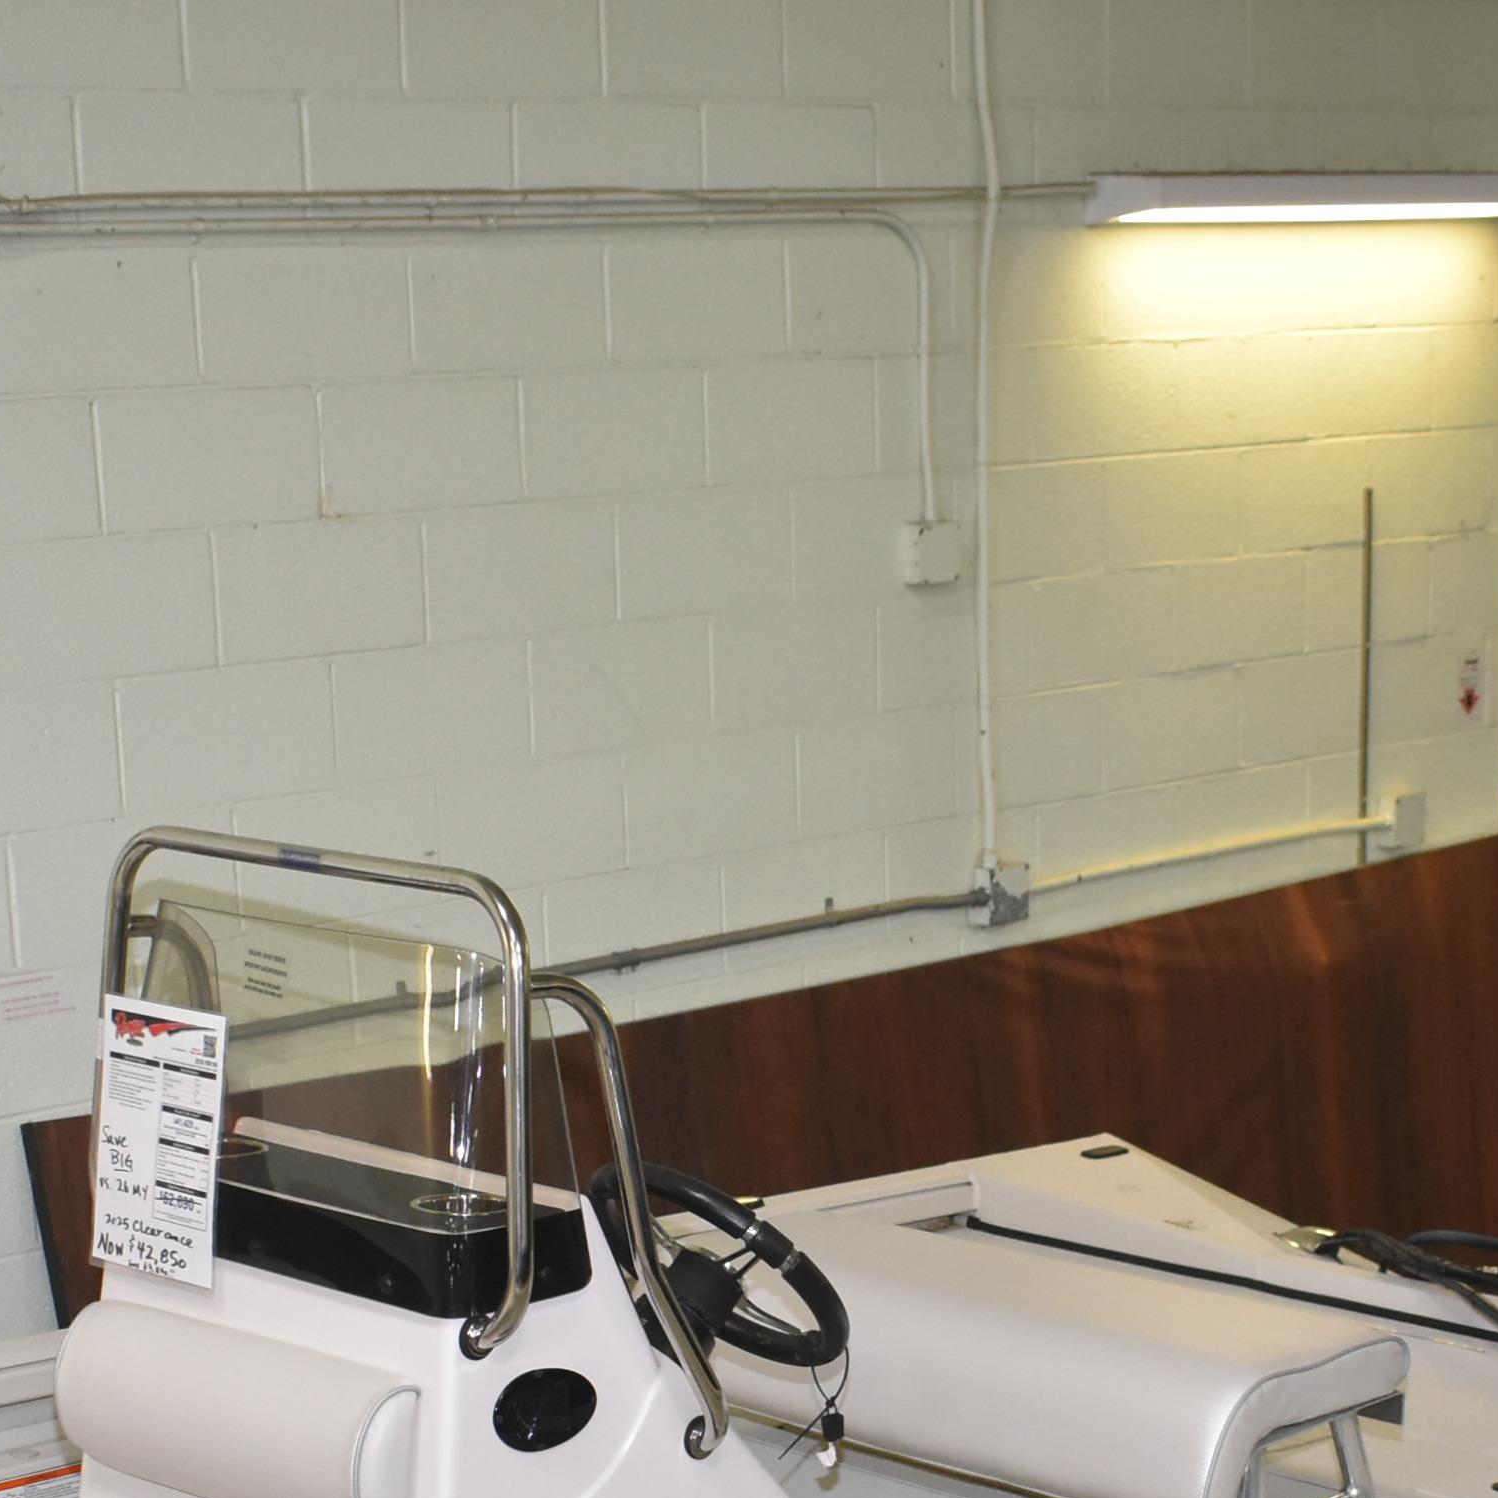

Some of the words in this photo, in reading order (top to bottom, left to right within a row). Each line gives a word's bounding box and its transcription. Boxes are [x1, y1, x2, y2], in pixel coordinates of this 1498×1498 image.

[101, 1125, 128, 1148] Save
[110, 1149, 133, 1171] BIG
[105, 1212, 129, 1231] 2025
[128, 1234, 187, 1270] $42,850
